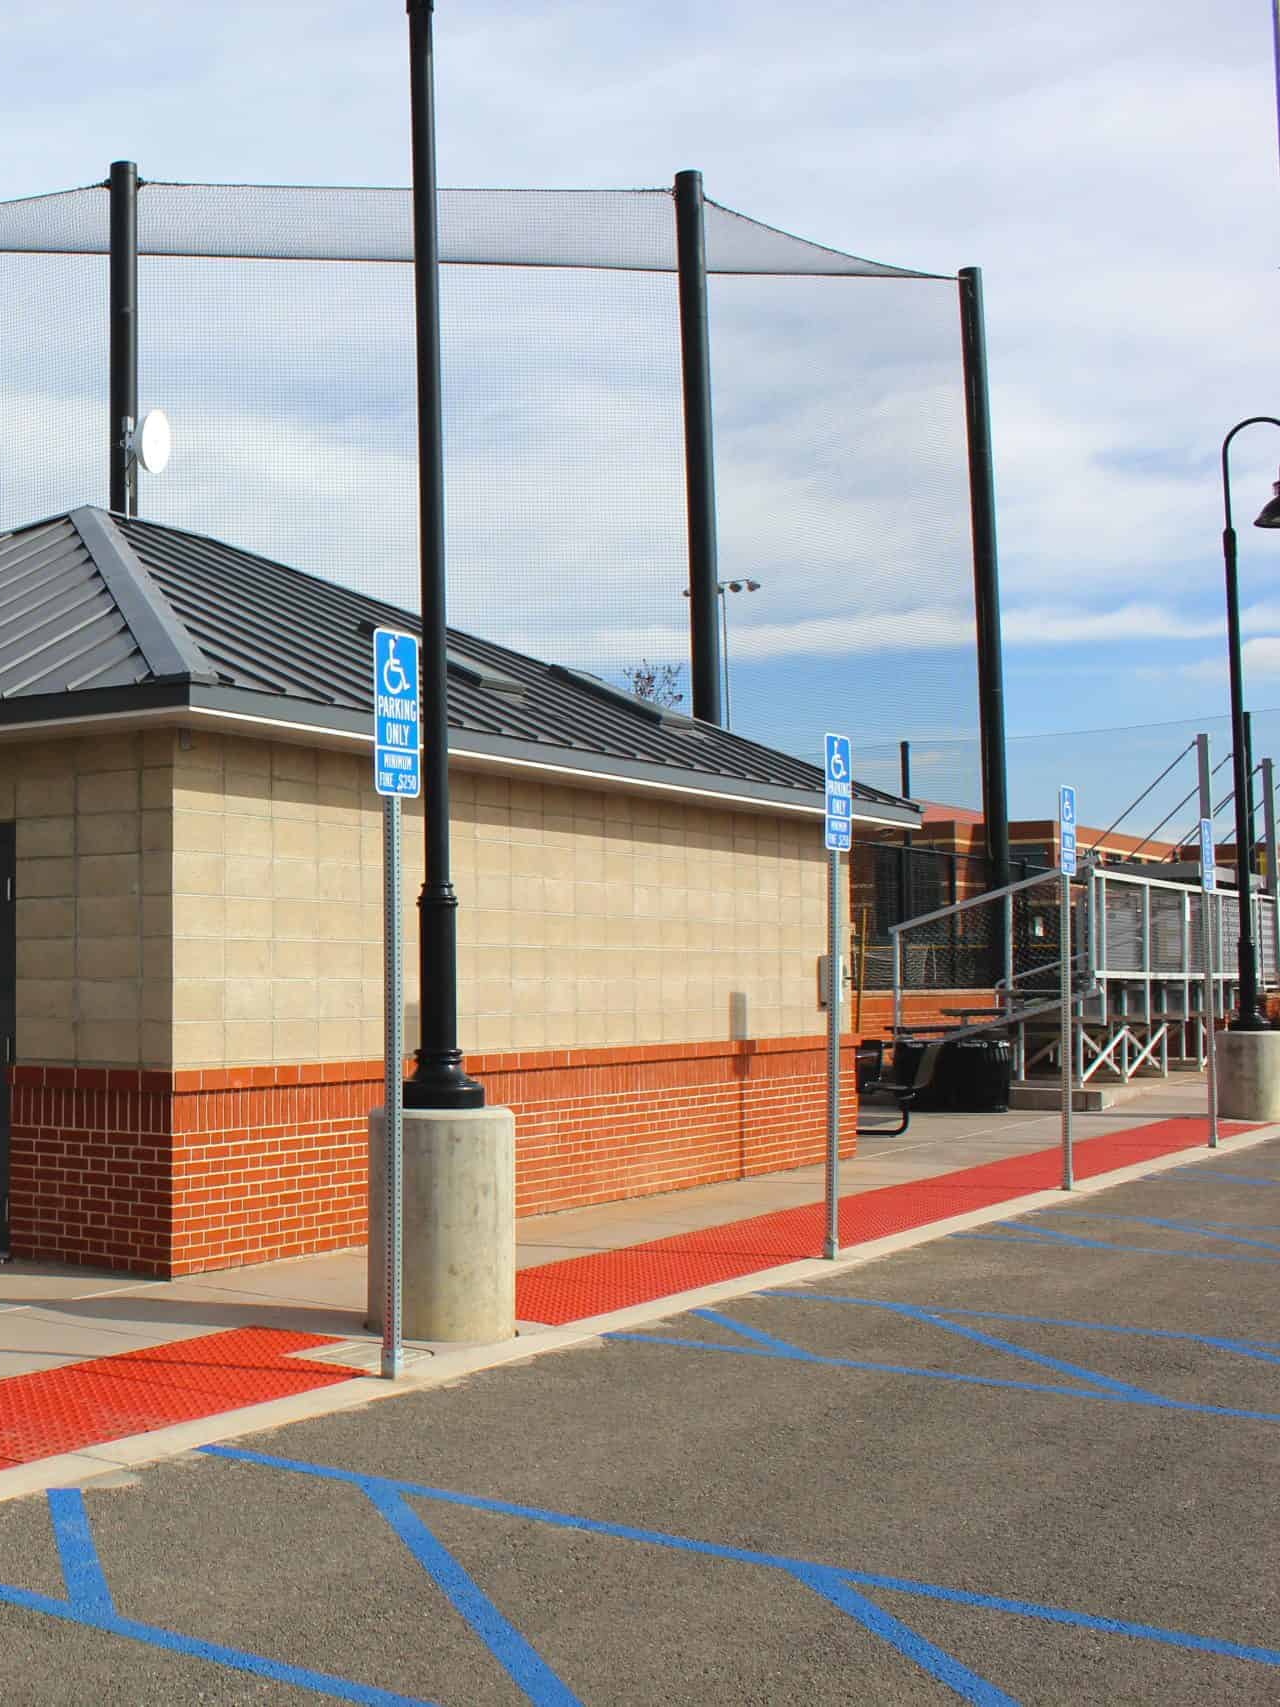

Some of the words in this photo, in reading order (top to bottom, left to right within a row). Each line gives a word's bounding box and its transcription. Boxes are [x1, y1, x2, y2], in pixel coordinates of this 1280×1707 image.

[378, 695, 417, 722] PARKING
[386, 722, 410, 746] ONLY
[383, 753, 413, 770] MINIMUM
[380, 771, 394, 787] FINE
[398, 774, 417, 790] $250
